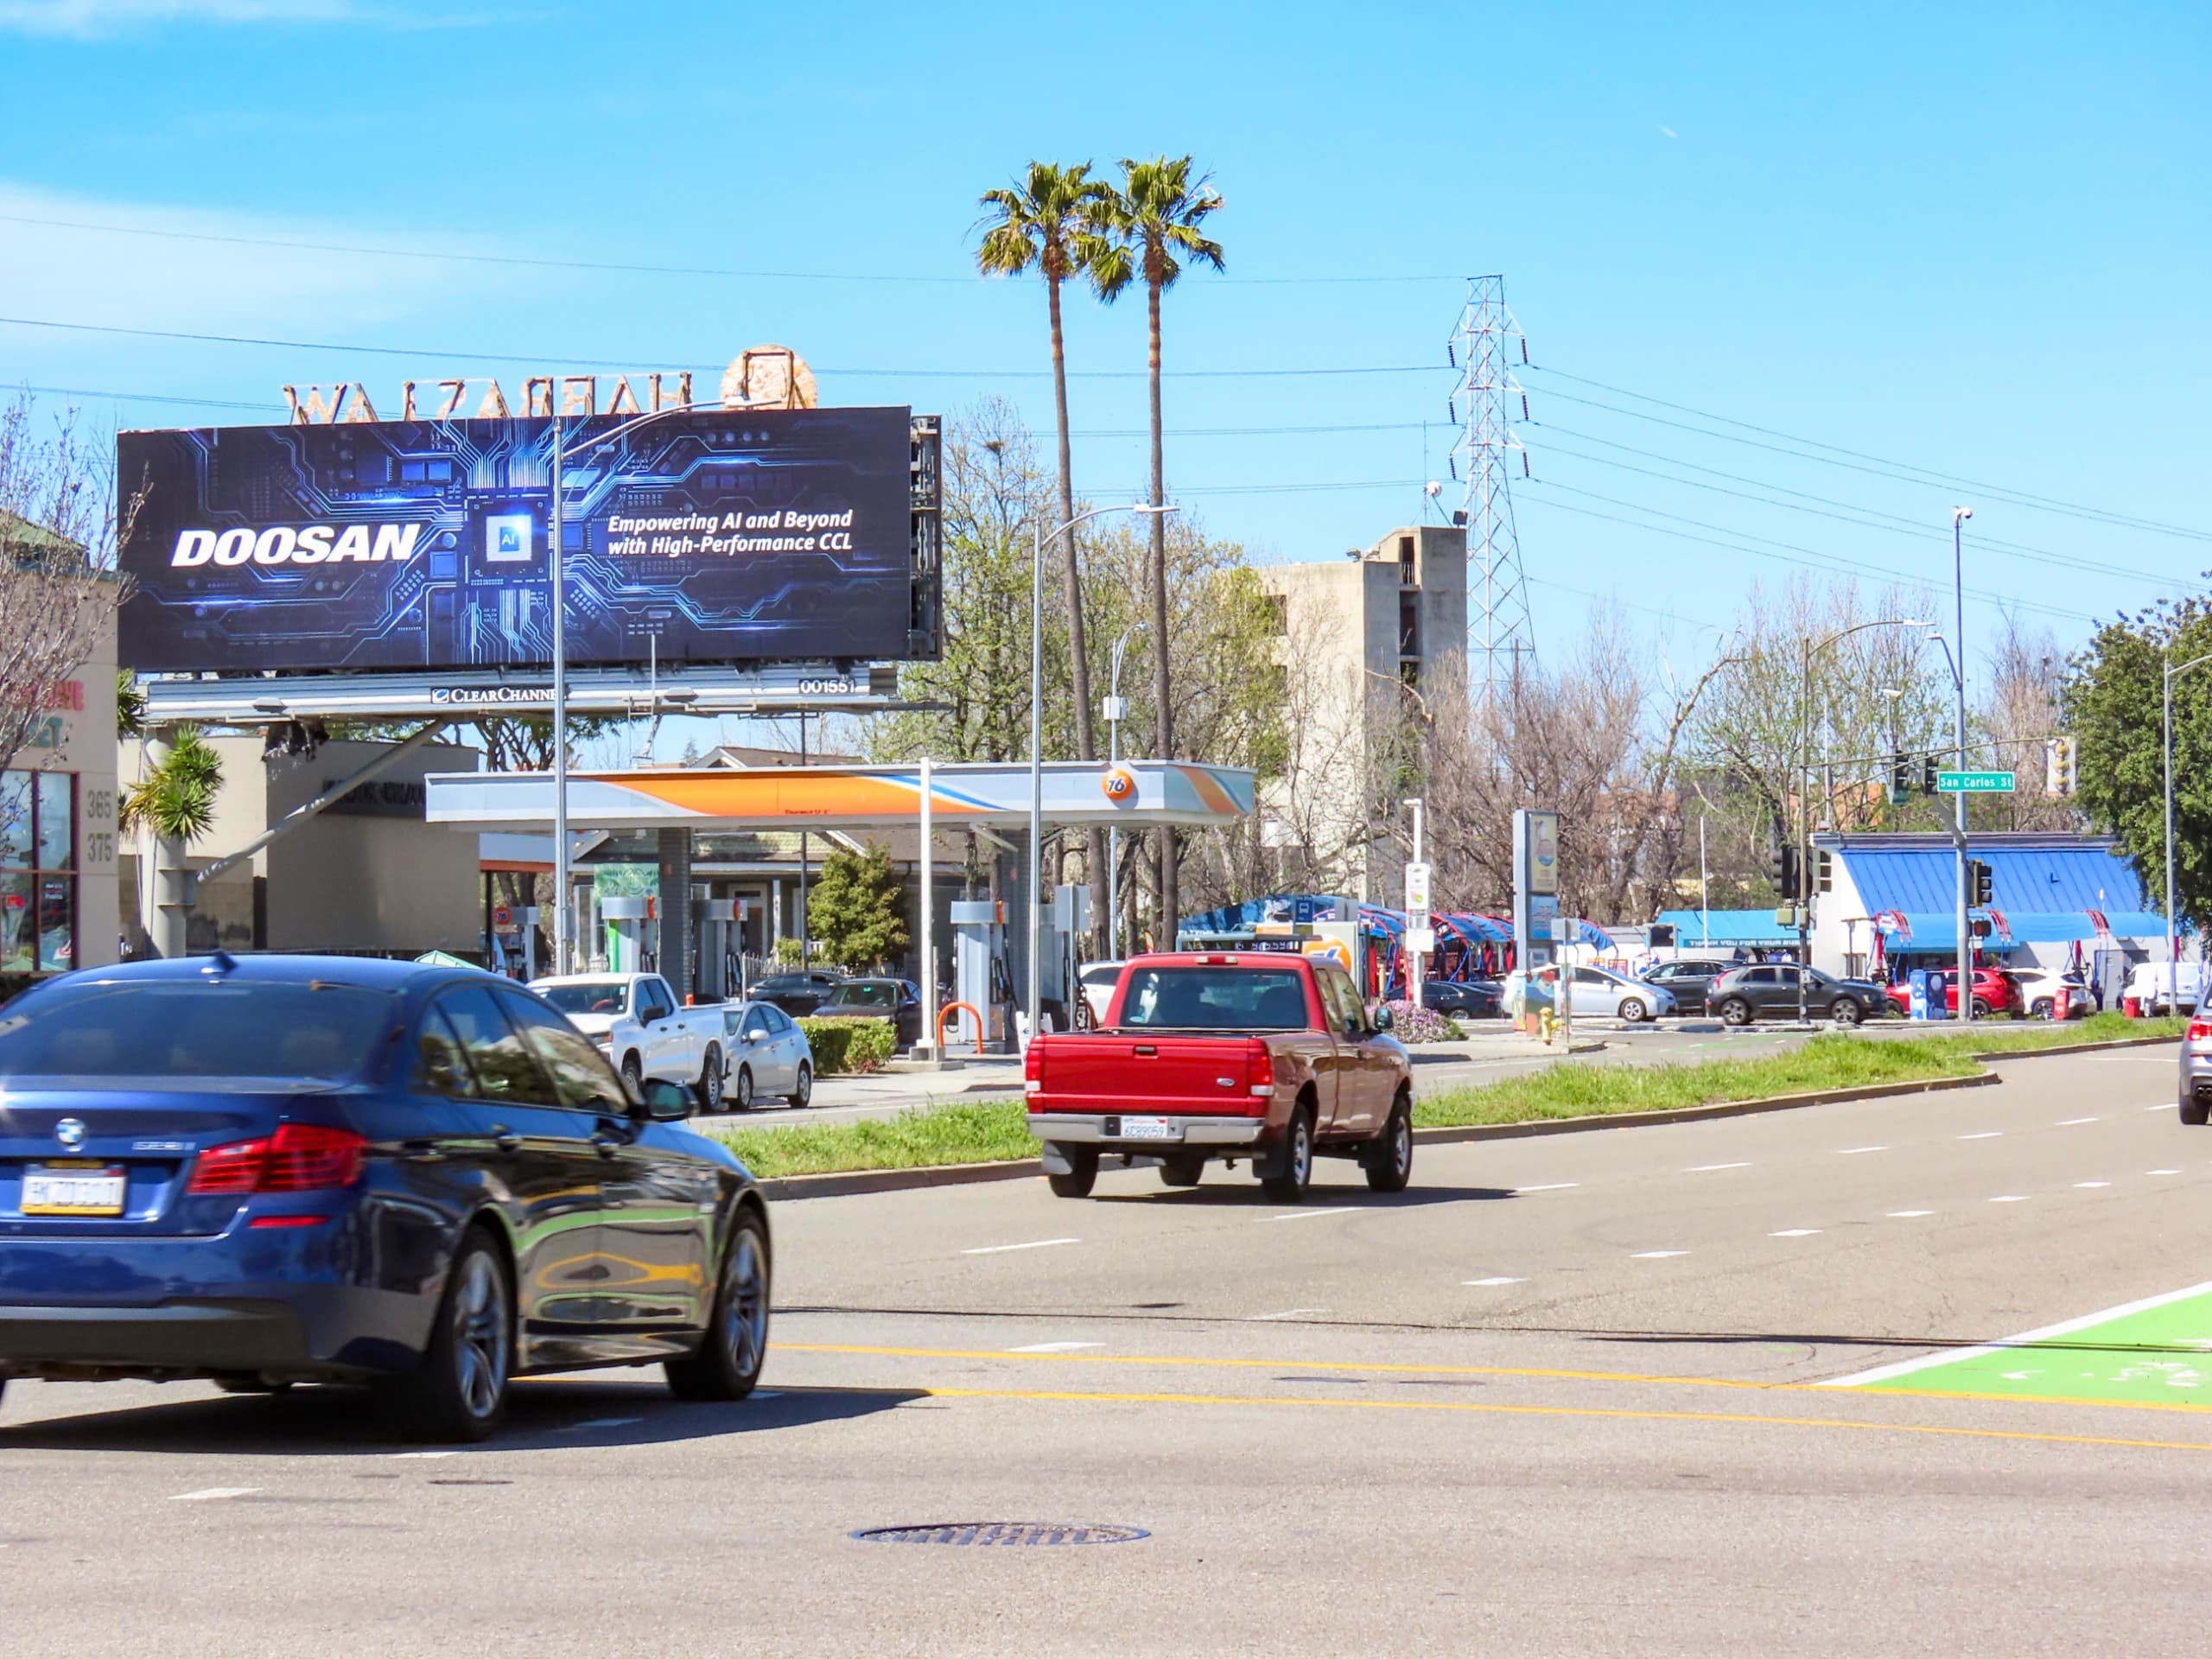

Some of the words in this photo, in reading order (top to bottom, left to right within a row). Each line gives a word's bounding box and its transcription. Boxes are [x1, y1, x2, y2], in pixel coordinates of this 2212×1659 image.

[607, 515, 718, 535] Empowering
[721, 512, 742, 530] AI
[746, 511, 780, 528] and
[784, 509, 854, 531] Beyond
[170, 523, 421, 567] DOOSAN
[501, 533, 516, 545] AI
[608, 536, 647, 555] with
[651, 533, 814, 557] High-Performance
[819, 532, 852, 550] CCL
[800, 679, 855, 694] 001551
[1109, 779, 1125, 792] 76
[1940, 777, 1959, 787] San
[1963, 777, 1996, 787] Carlos
[2000, 777, 2012, 787] St
[87, 790, 111, 818] 365
[87, 833, 111, 862] 375
